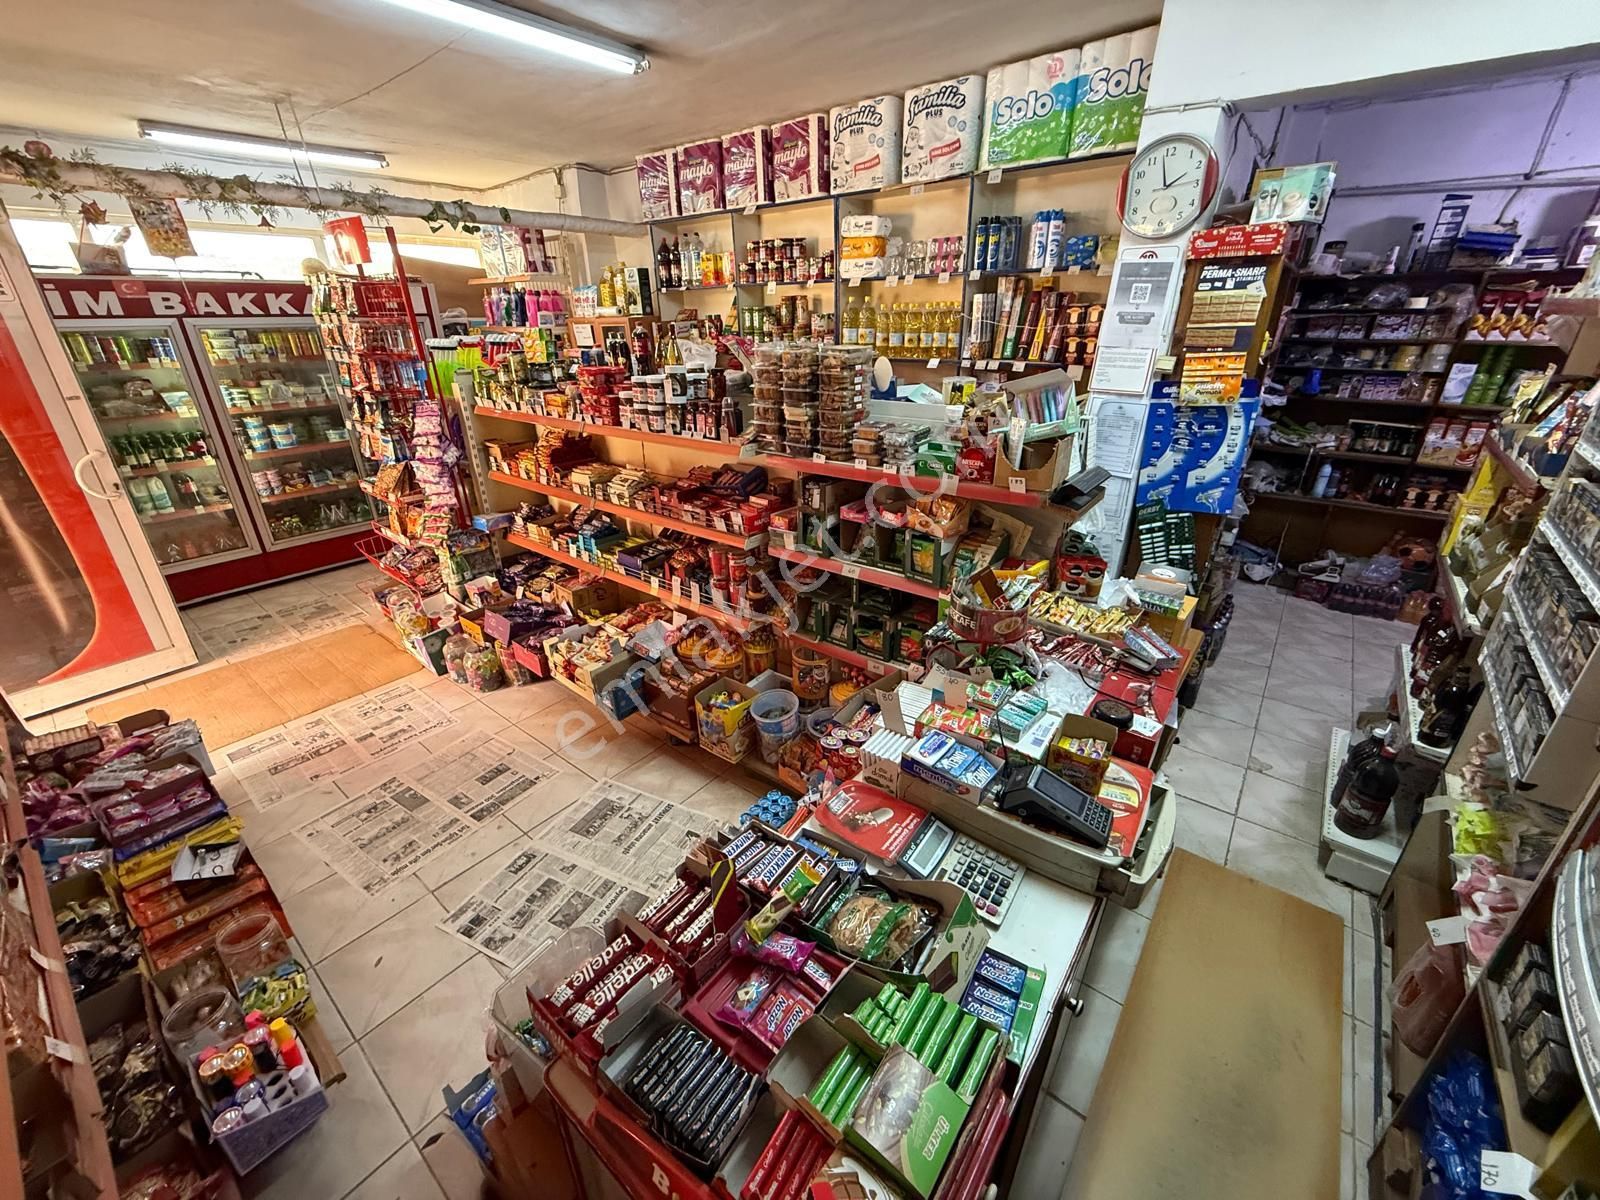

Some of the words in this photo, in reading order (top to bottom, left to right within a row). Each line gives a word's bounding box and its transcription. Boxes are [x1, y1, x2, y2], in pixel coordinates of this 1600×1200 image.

[908, 85, 966, 126] familia
[925, 109, 944, 118] PLUS
[995, 90, 1055, 126] Solo
[834, 105, 883, 141] familia
[850, 126, 865, 137] PLUS
[774, 142, 807, 167] maylo
[1147, 156, 1158, 166] 11
[1165, 146, 1177, 157] 12
[680, 160, 714, 183] maylo
[1136, 170, 1146, 180] 10
[1200, 267, 1267, 279] PERMA-SHARP
[1143, 602, 1168, 615] ALIM
[913, 764, 954, 788] mentos
[652, 803, 674, 825] SERHAYAT
[726, 831, 756, 857] SNICKER
[735, 841, 766, 867] SNICKER
[748, 846, 780, 879] SNICKERS
[763, 847, 794, 883] SNICKERS
[573, 934, 632, 986] tadelle
[594, 954, 654, 1007] tadelle
[981, 966, 1016, 986] Nazar
[975, 987, 1010, 1006] Nazar
[767, 997, 788, 1030] Nazar
[784, 1006, 804, 1039] Nazar
[968, 1002, 1004, 1023] Nazar
[923, 1115, 950, 1160] ÜLKER
[1482, 1164, 1500, 1187] 170
